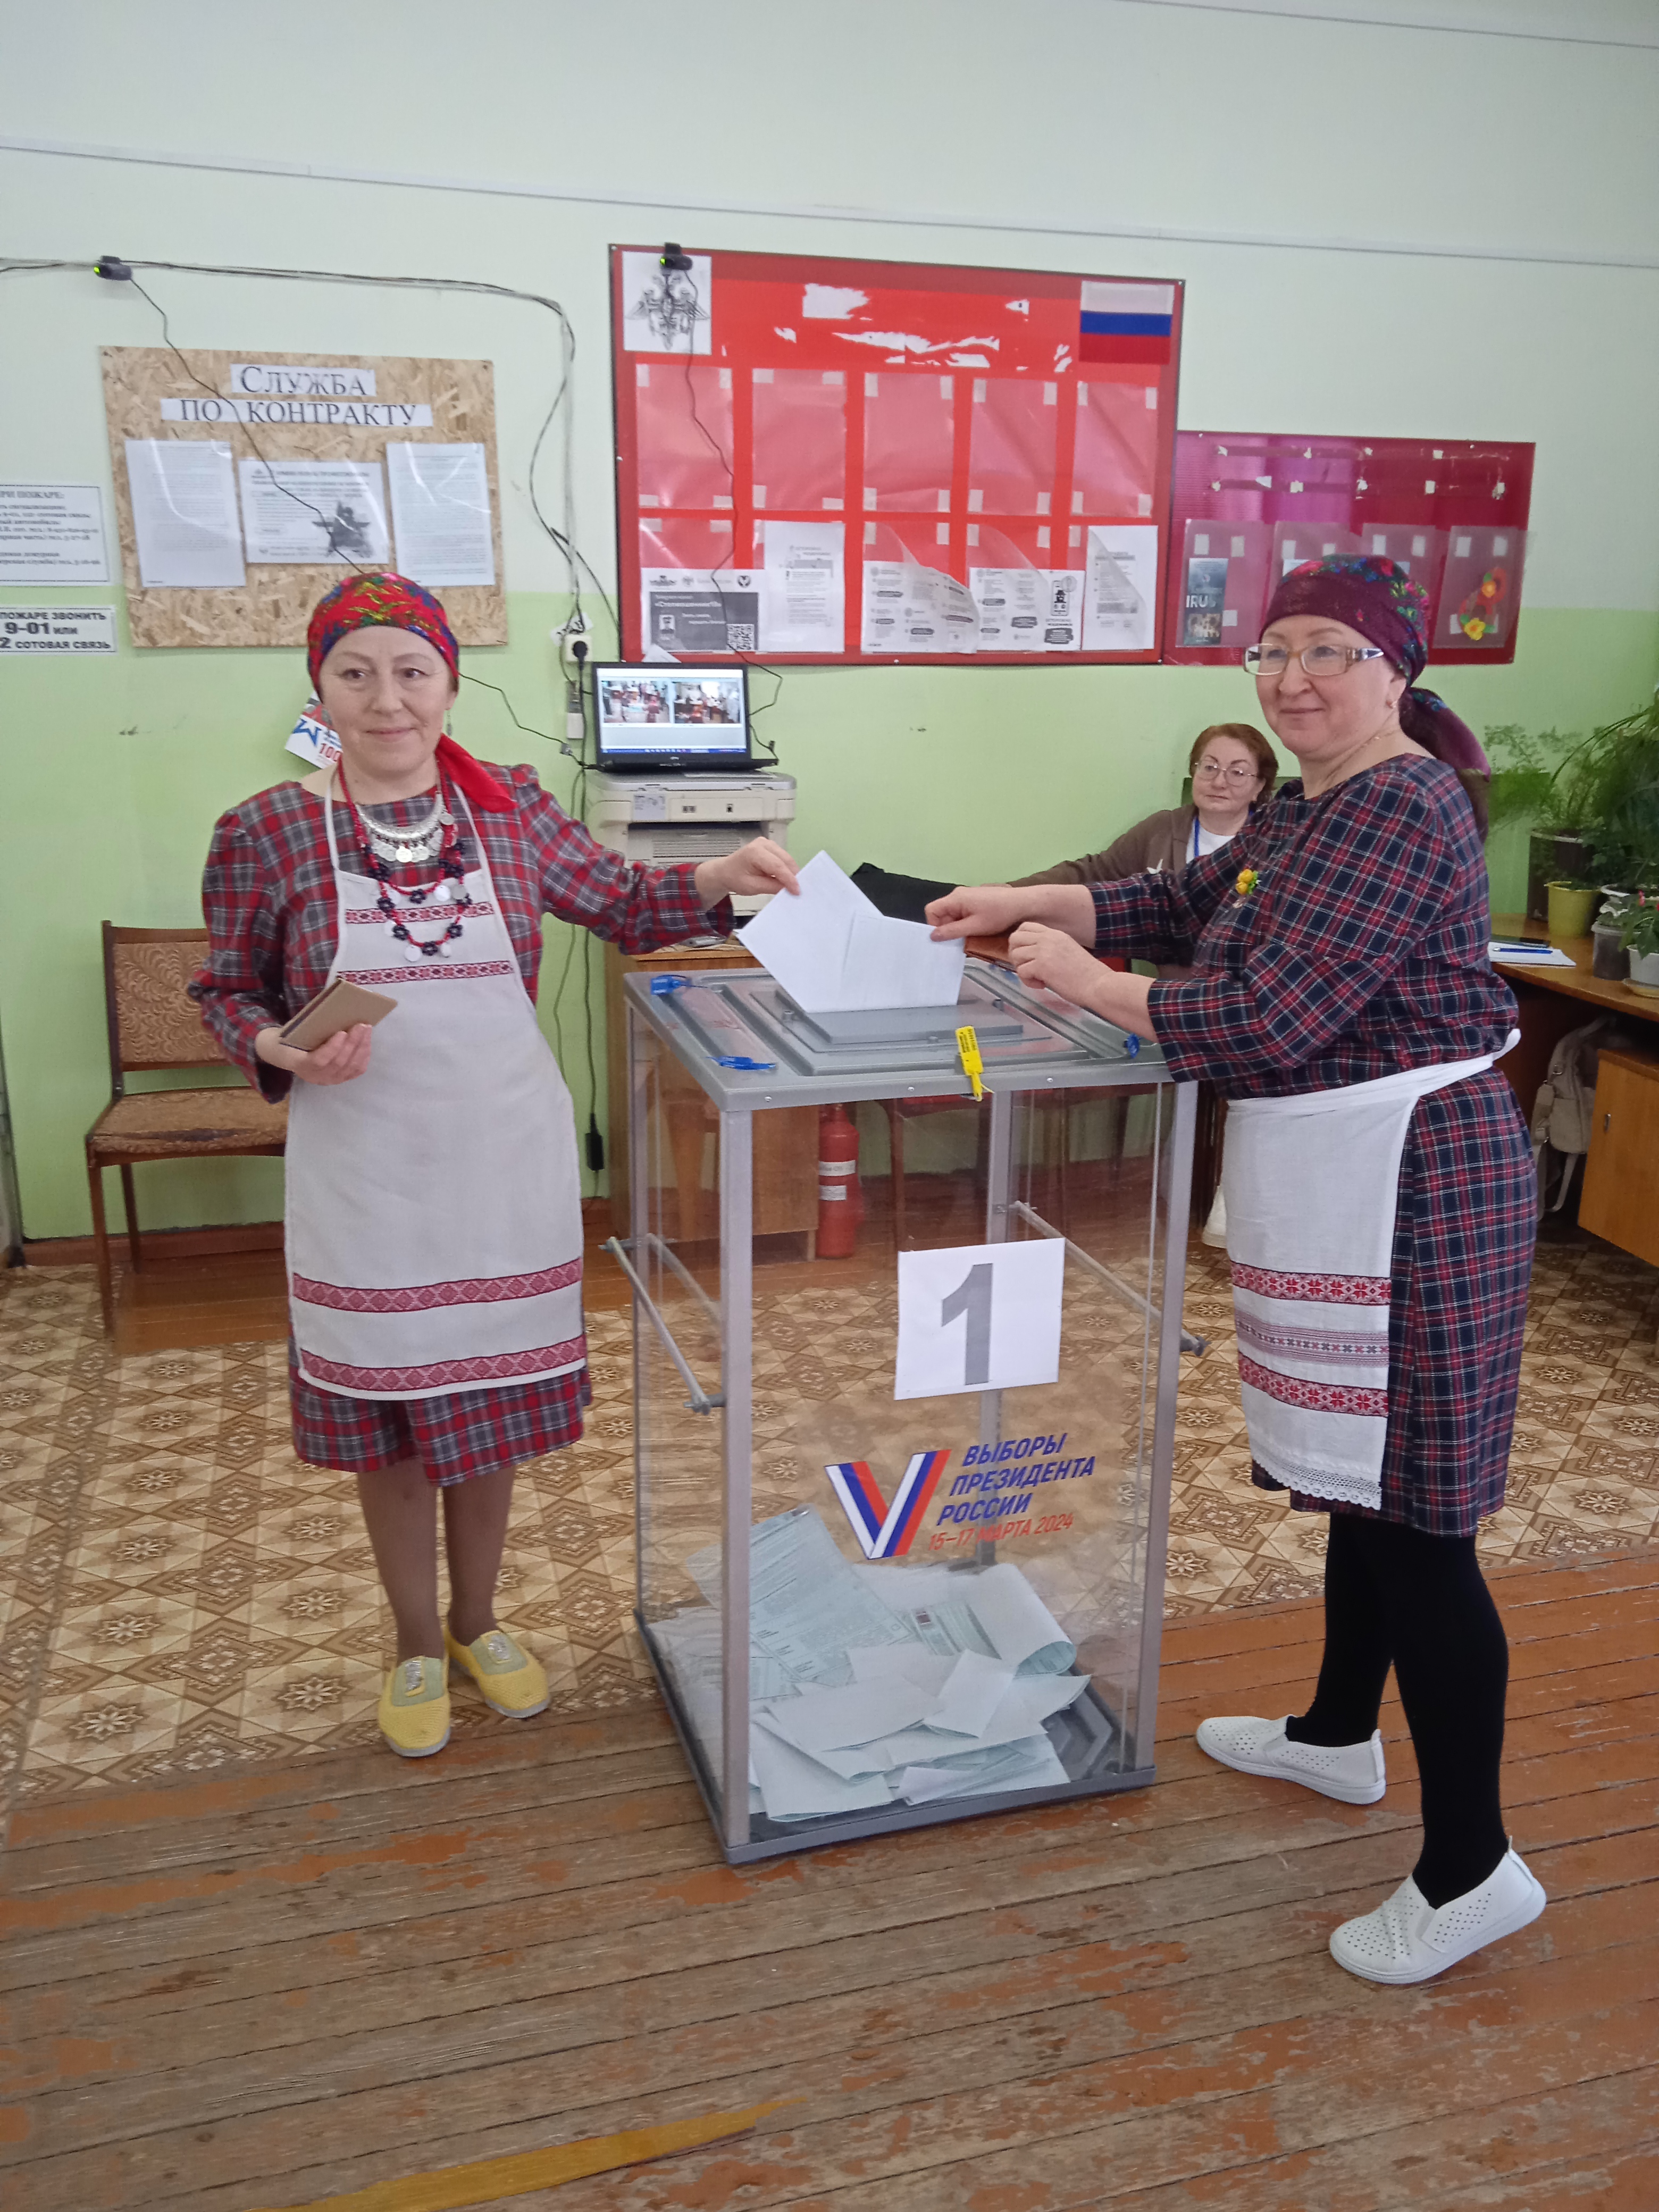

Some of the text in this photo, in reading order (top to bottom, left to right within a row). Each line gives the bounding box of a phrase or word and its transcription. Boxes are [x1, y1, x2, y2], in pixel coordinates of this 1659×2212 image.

[181, 399, 417, 425] ПО КОНТРАКТУ
[4, 622, 50, 634] 9-01
[52, 612, 106, 621] ЗВОНИТЬ
[941, 1263, 993, 1385] 1
[961, 1432, 1068, 1467] ВЫБОРЫ
[950, 1456, 1096, 1496] ПРЕЗИДЕНТА
[936, 1492, 1033, 1526] РОССИИ
[976, 1519, 1032, 1542] МАРТА
[1034, 1513, 1074, 1535] 2024
